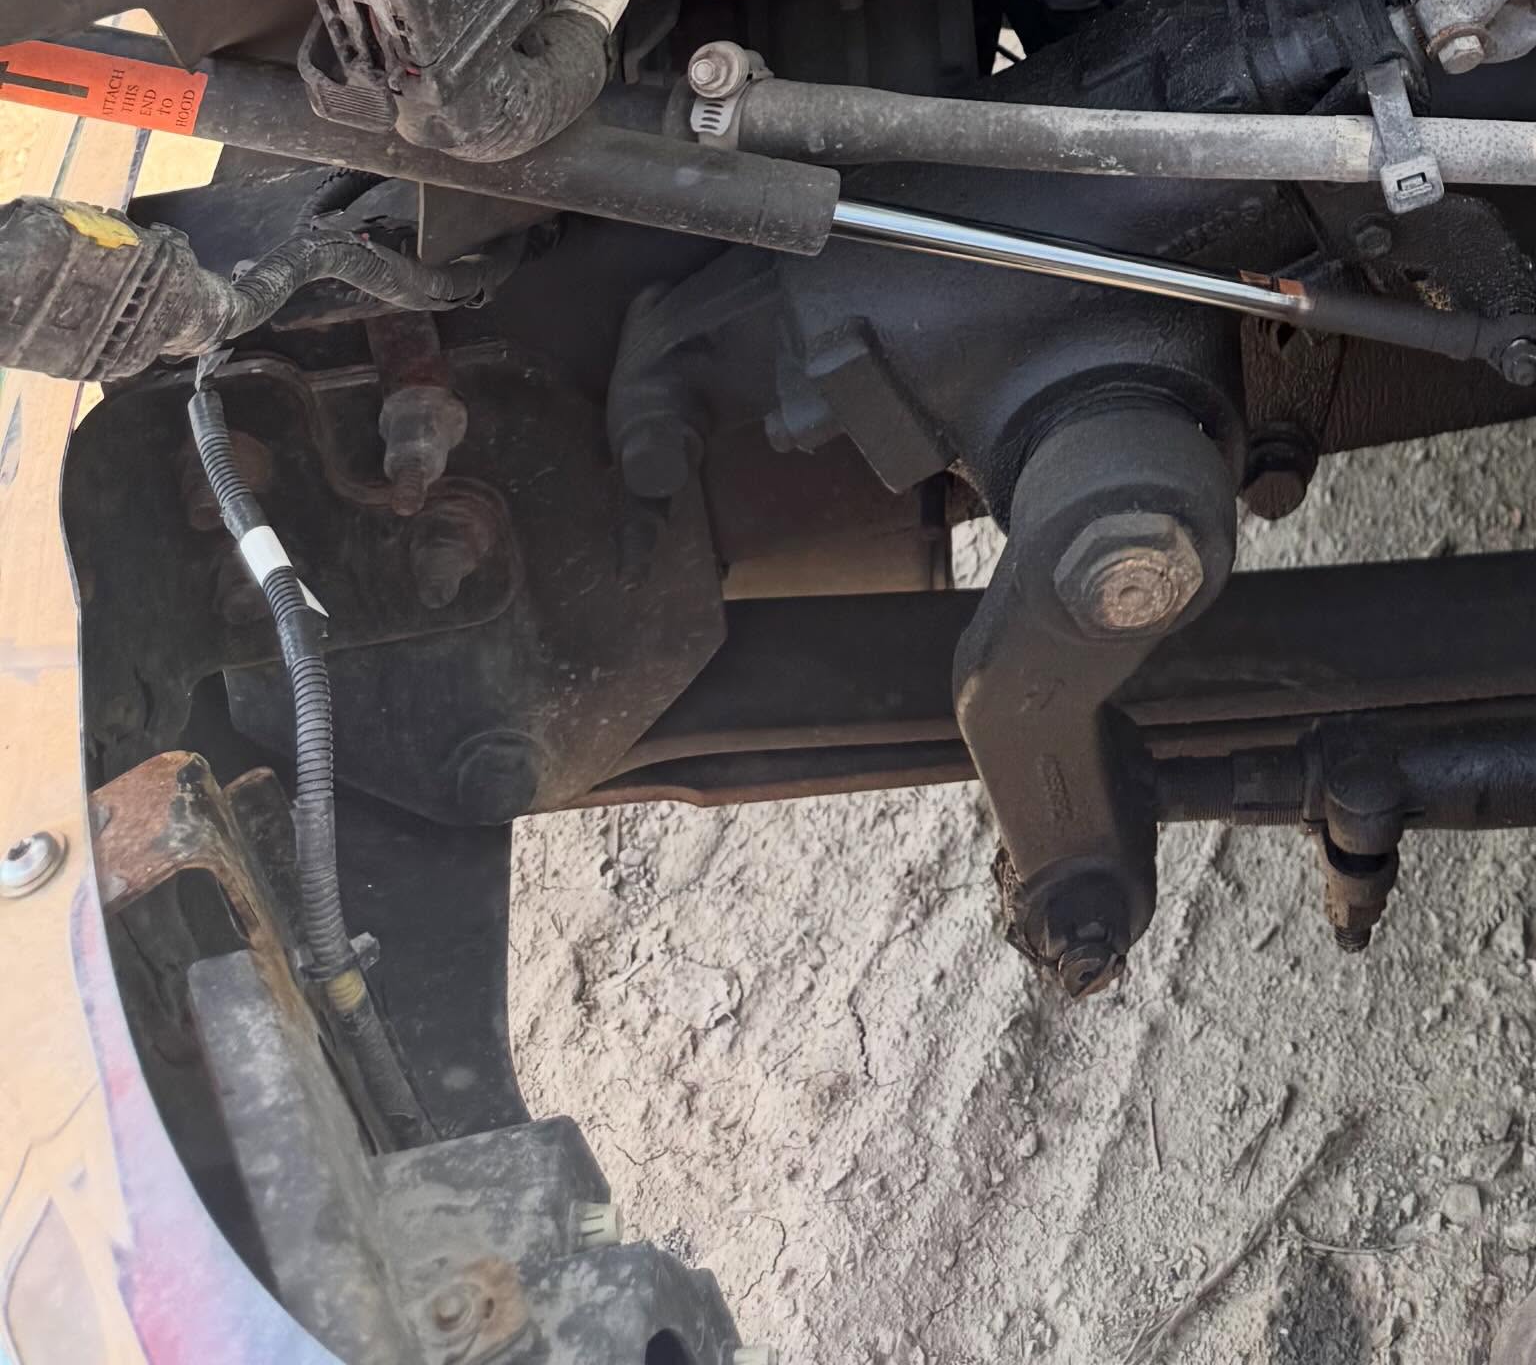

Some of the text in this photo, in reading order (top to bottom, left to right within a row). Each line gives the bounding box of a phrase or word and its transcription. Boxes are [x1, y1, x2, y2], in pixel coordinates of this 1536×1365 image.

[102, 68, 126, 116] ATTACH
[121, 84, 139, 113] THIS
[140, 89, 157, 117] END
[158, 97, 173, 116] TO
[176, 89, 196, 128] HOOD
